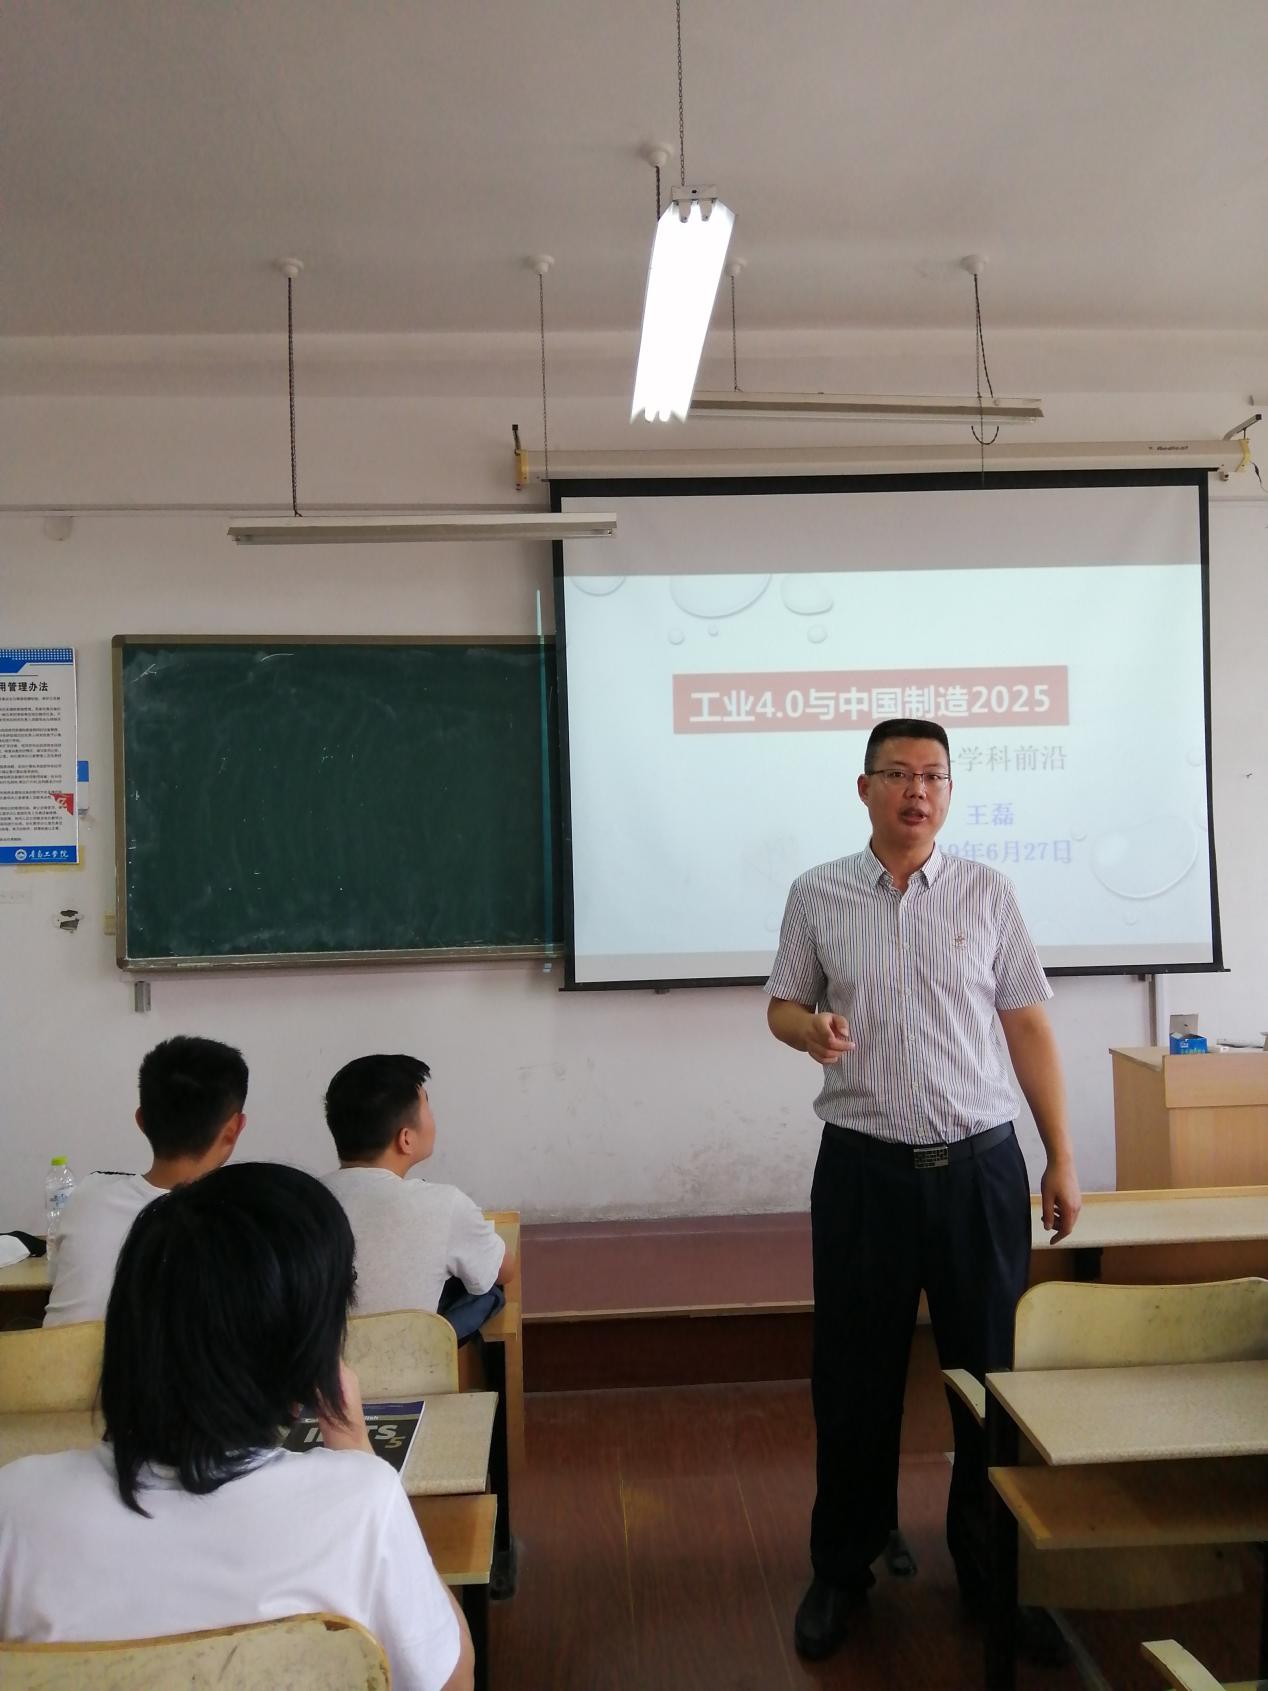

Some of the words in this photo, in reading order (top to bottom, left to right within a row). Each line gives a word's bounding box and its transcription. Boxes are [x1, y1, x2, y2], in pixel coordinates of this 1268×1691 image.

[689, 684, 1051, 722] 工业4.0与中国制造2025
[967, 802, 1014, 826] 王磊
